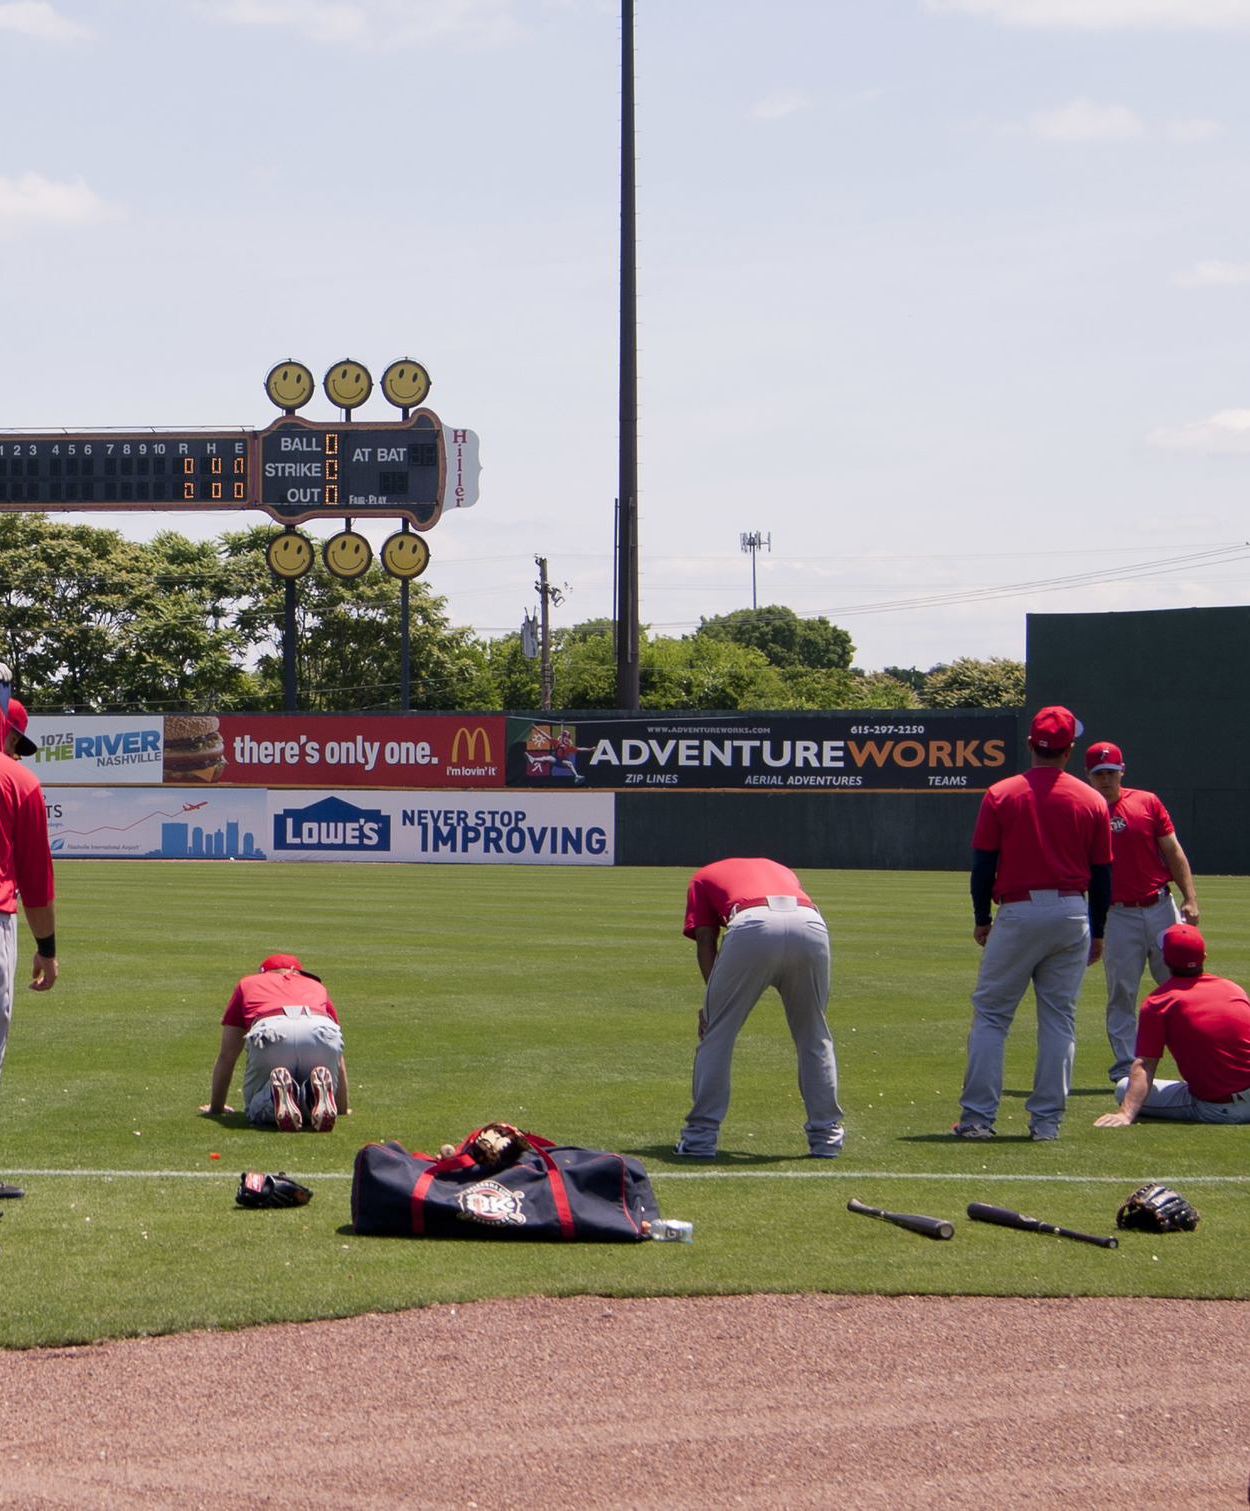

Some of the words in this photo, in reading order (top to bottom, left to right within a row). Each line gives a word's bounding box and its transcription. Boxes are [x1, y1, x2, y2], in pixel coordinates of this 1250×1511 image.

[13, 445, 21, 455] 2
[29, 445, 37, 455] 3
[52, 445, 60, 455] 4
[68, 445, 76, 455] 5
[84, 445, 92, 455] 6
[106, 444, 114, 454] 7
[123, 444, 131, 454] 8
[139, 444, 147, 454] 9
[153, 444, 166, 454] 10
[179, 443, 188, 454] R
[207, 443, 216, 454] H
[235, 443, 243, 453] E
[281, 437, 321, 451] BALL
[352, 448, 371, 462] AT
[377, 448, 407, 462] BAT
[265, 463, 321, 477] STRIKE
[453, 429, 468, 508] Hiller
[287, 488, 321, 502] OUT
[850, 726, 925, 734] 615-297-2250
[35, 745, 74, 763] THE
[75, 730, 161, 759] RIVER
[40, 733, 74, 746] 107.5
[97, 752, 161, 767] NASHVILLE
[233, 735, 320, 765] there's
[325, 735, 380, 771] only
[385, 741, 439, 765] one.
[488, 766, 496, 775] it
[625, 774, 644, 783] ZIP
[646, 774, 678, 784] LINES
[745, 775, 784, 785] AERIAL
[786, 775, 862, 786] ADVENTURES
[928, 775, 967, 786] TEAMS
[402, 809, 468, 826] NEVER
[474, 810, 526, 827] STOP
[286, 817, 380, 845] LOWE'S
[420, 825, 607, 855] IMPROVING
